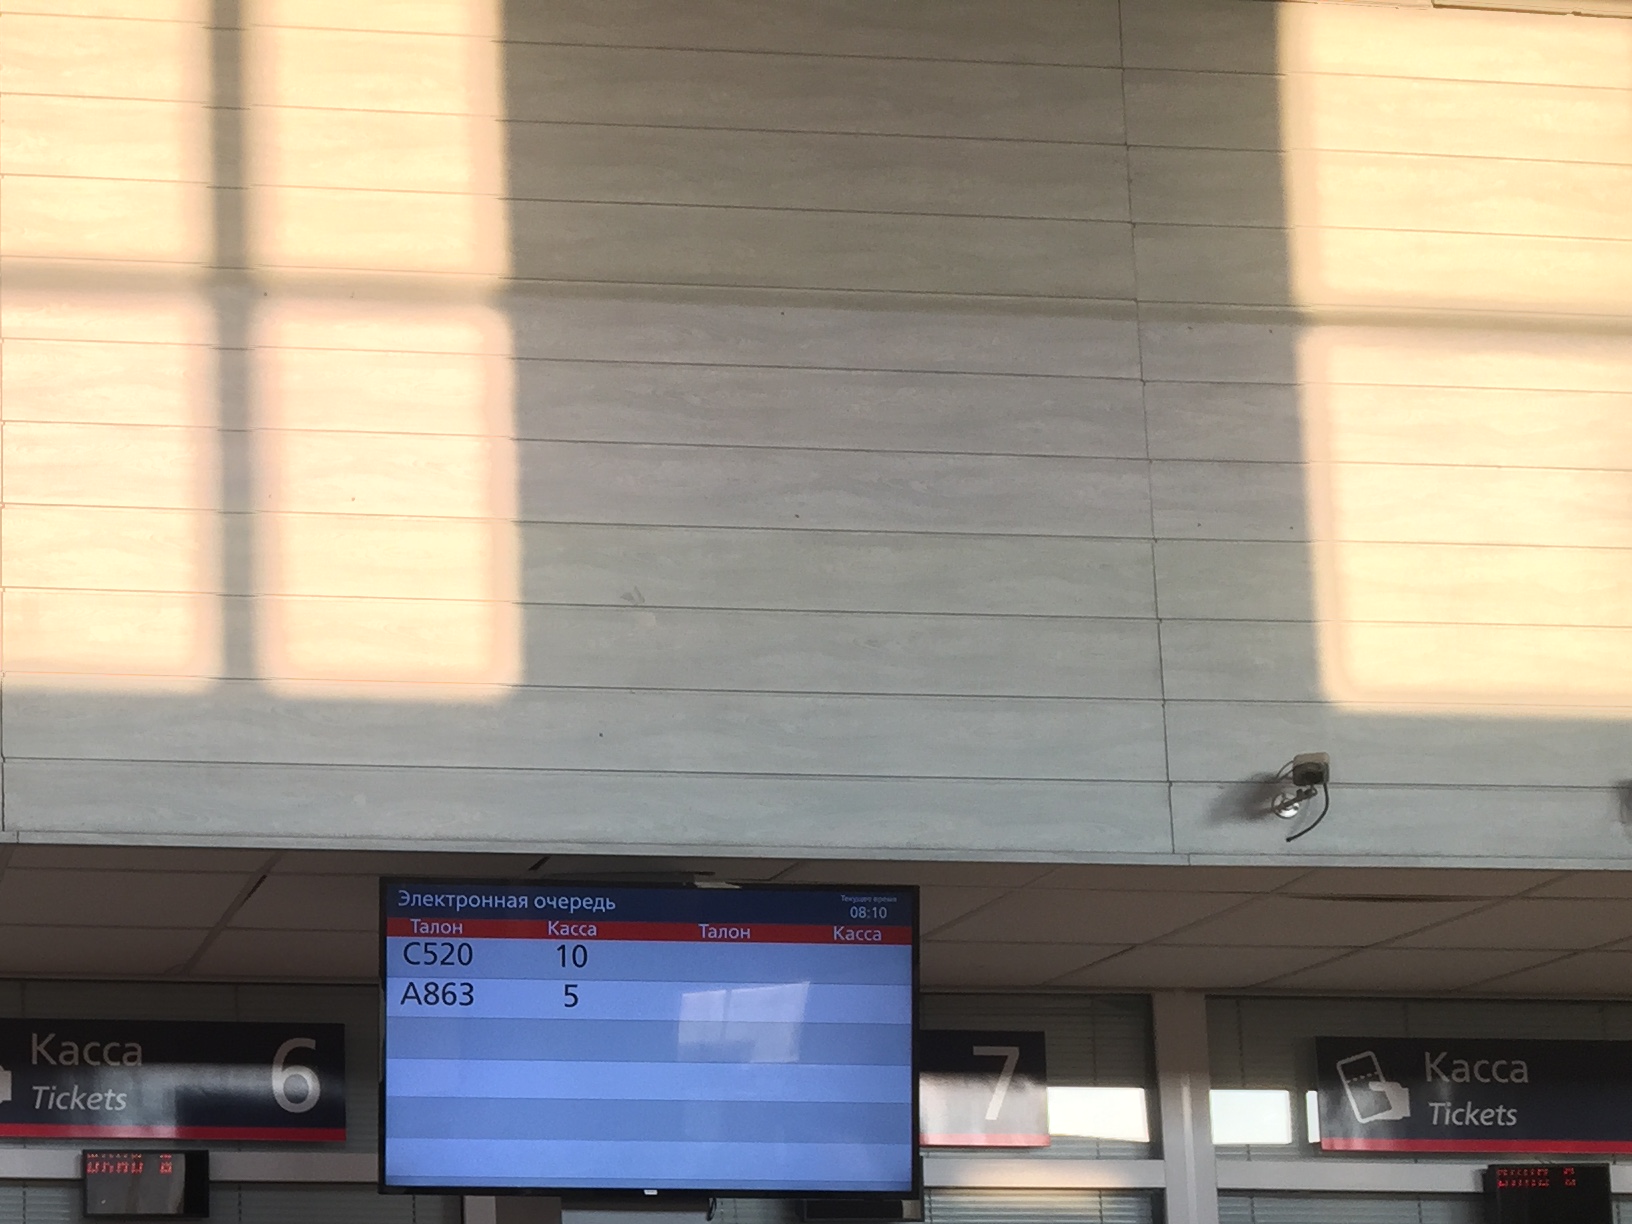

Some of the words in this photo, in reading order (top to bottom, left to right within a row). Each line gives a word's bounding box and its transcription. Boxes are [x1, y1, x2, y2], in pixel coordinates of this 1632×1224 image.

[398, 890, 528, 911] Электронная
[534, 895, 616, 913] очередь
[850, 906, 887, 919] 08:10
[410, 918, 463, 934] Талон
[548, 920, 597, 936] Касса
[698, 923, 751, 939] Талон
[833, 926, 882, 941] Касса
[557, 944, 588, 968] 10
[563, 984, 579, 1008] 5
[30, 1032, 143, 1068] Касса
[271, 1037, 321, 1113] 6
[1423, 1050, 1529, 1084] Касса
[971, 1045, 1021, 1121] 7
[31, 1085, 128, 1112] Tickets
[1428, 1101, 1518, 1129] Tickets
